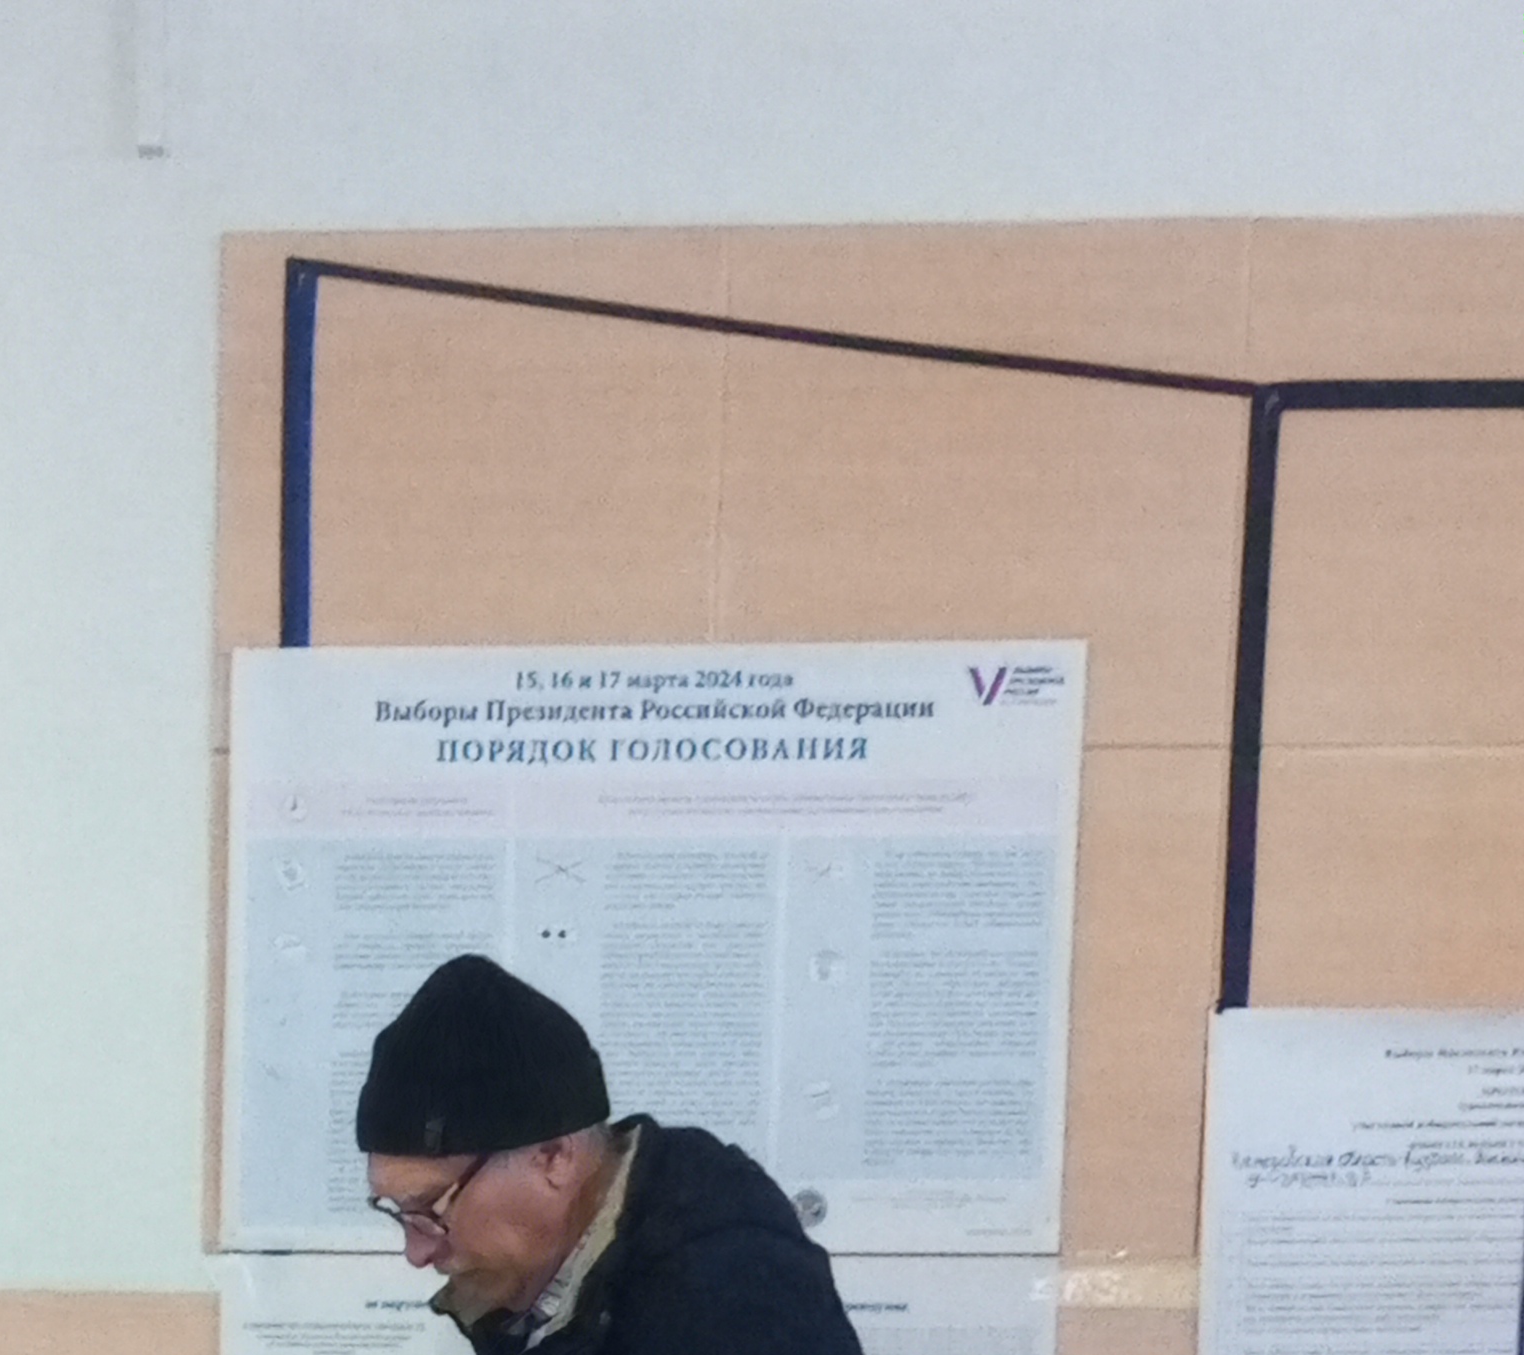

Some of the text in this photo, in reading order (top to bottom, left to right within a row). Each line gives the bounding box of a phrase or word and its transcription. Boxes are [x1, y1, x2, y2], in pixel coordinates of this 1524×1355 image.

[551, 671, 573, 690] 16
[578, 676, 592, 689] и
[599, 671, 620, 689] 17
[627, 674, 688, 693] марта
[694, 670, 742, 688] 2024
[746, 675, 793, 688] года
[375, 698, 934, 728] Выборы Президента Российской Федерации
[436, 737, 869, 765] ПОРЯДОК ГОЛОСОВАНИЯ
